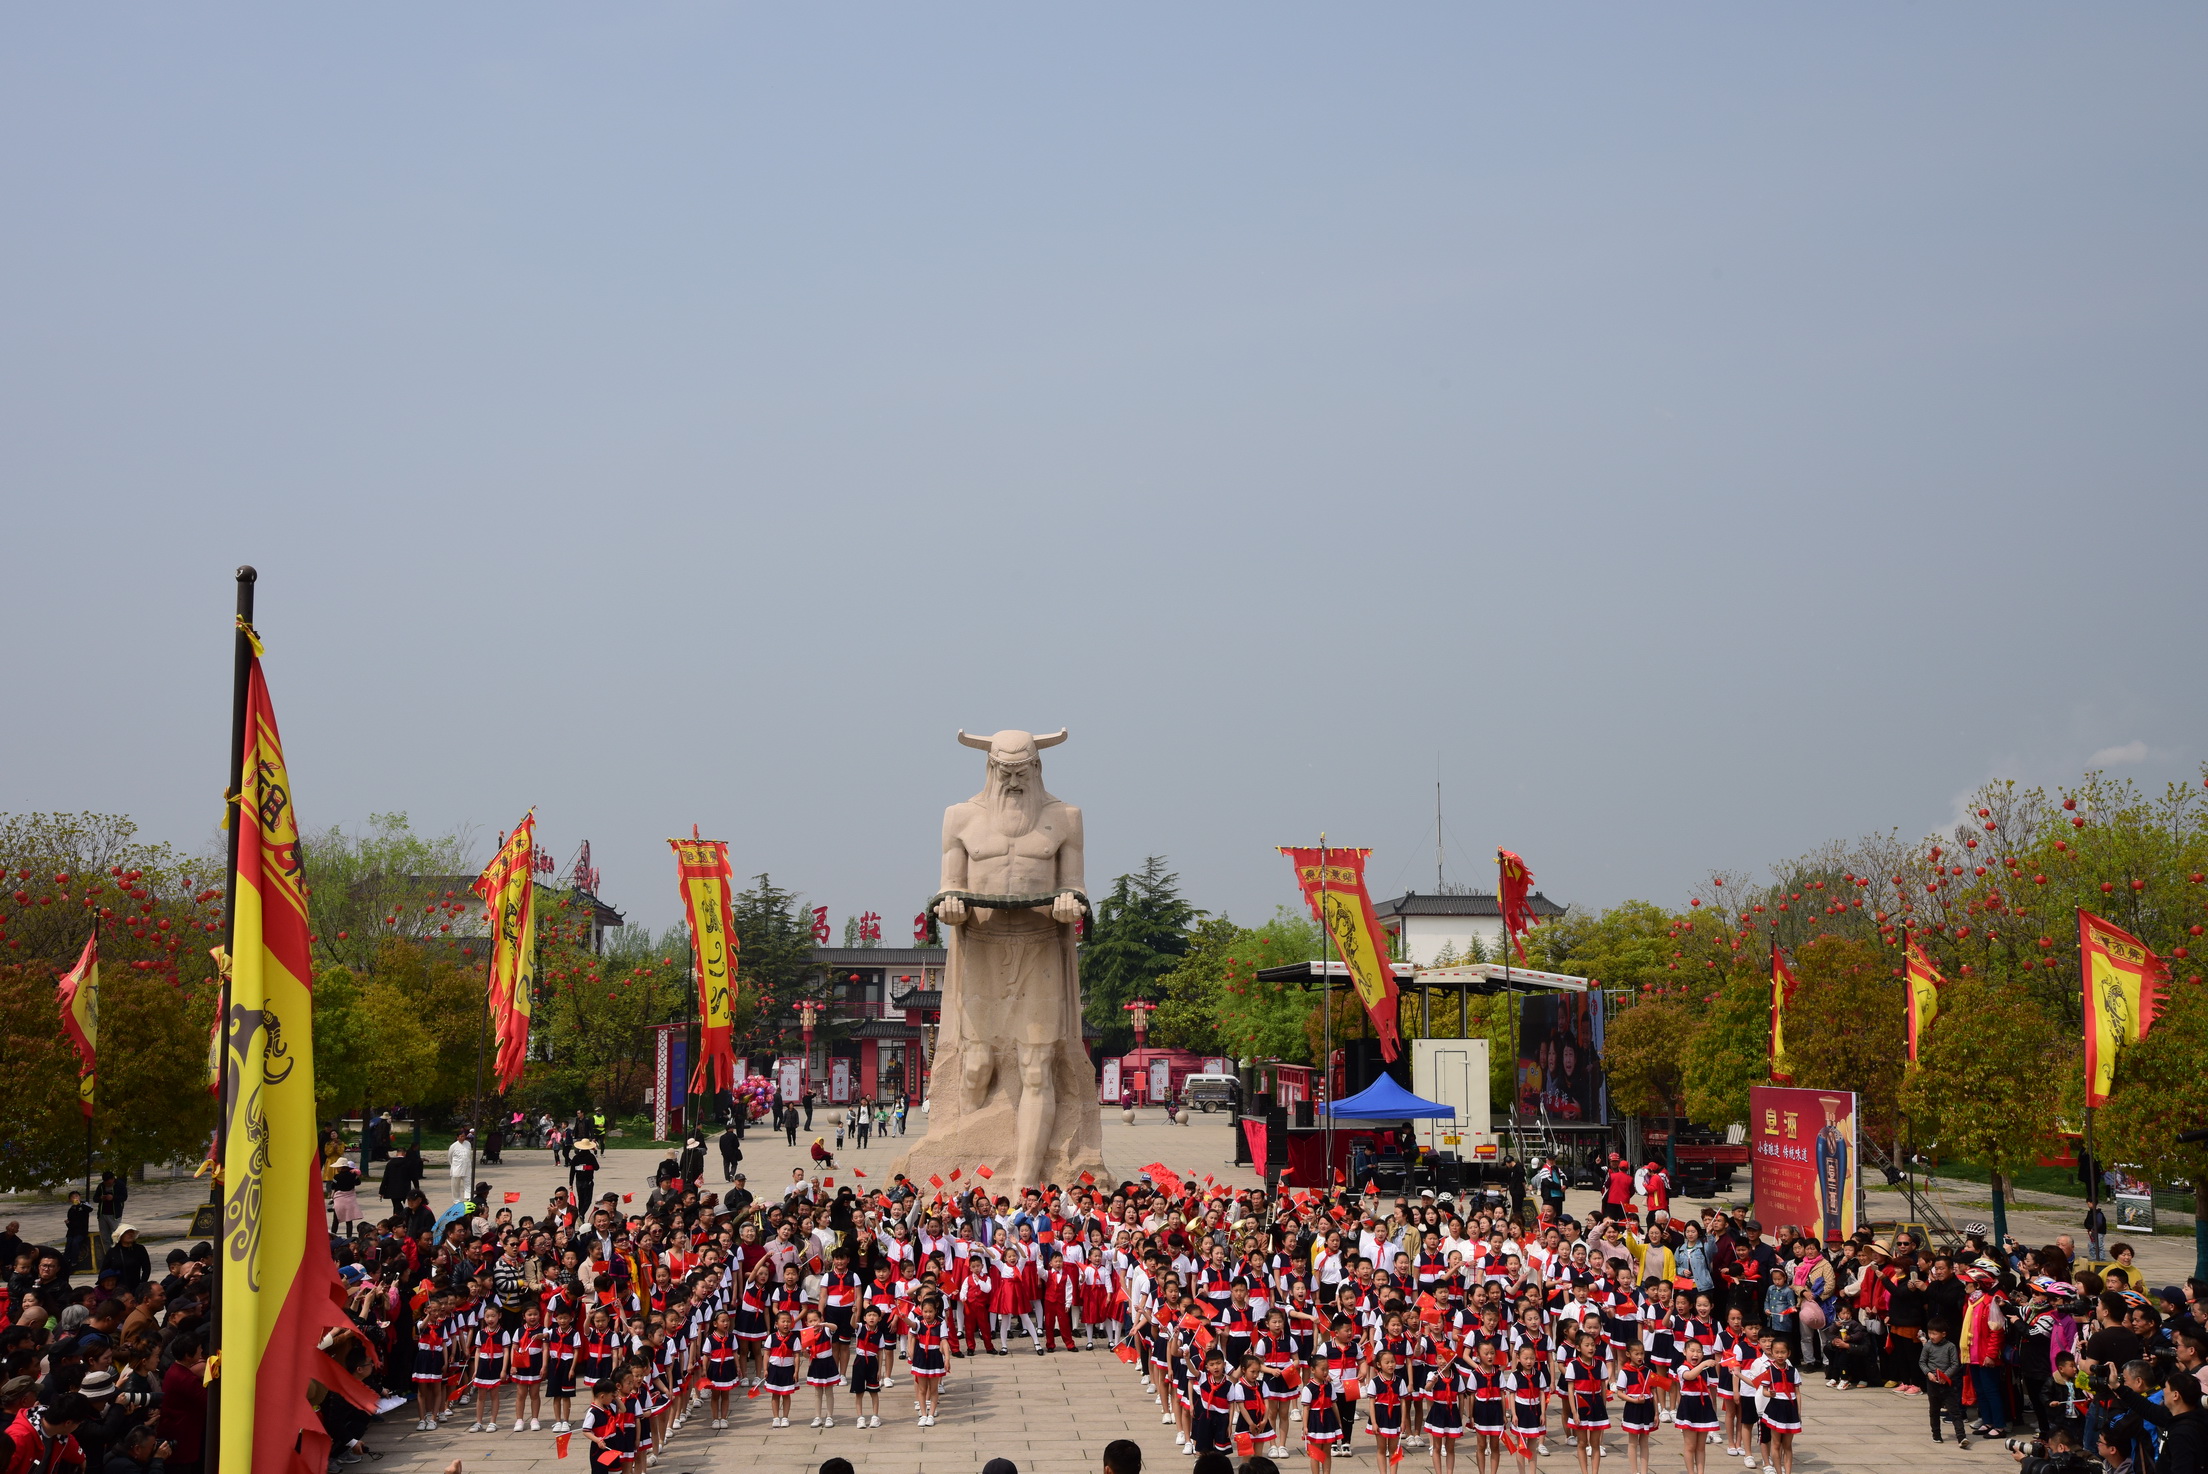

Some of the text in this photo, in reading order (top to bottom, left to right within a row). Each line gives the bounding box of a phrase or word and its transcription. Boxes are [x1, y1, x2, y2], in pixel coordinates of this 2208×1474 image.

[1765, 1107, 1799, 1139] 宣酒
[1782, 1144, 1808, 1163] 传统味道
